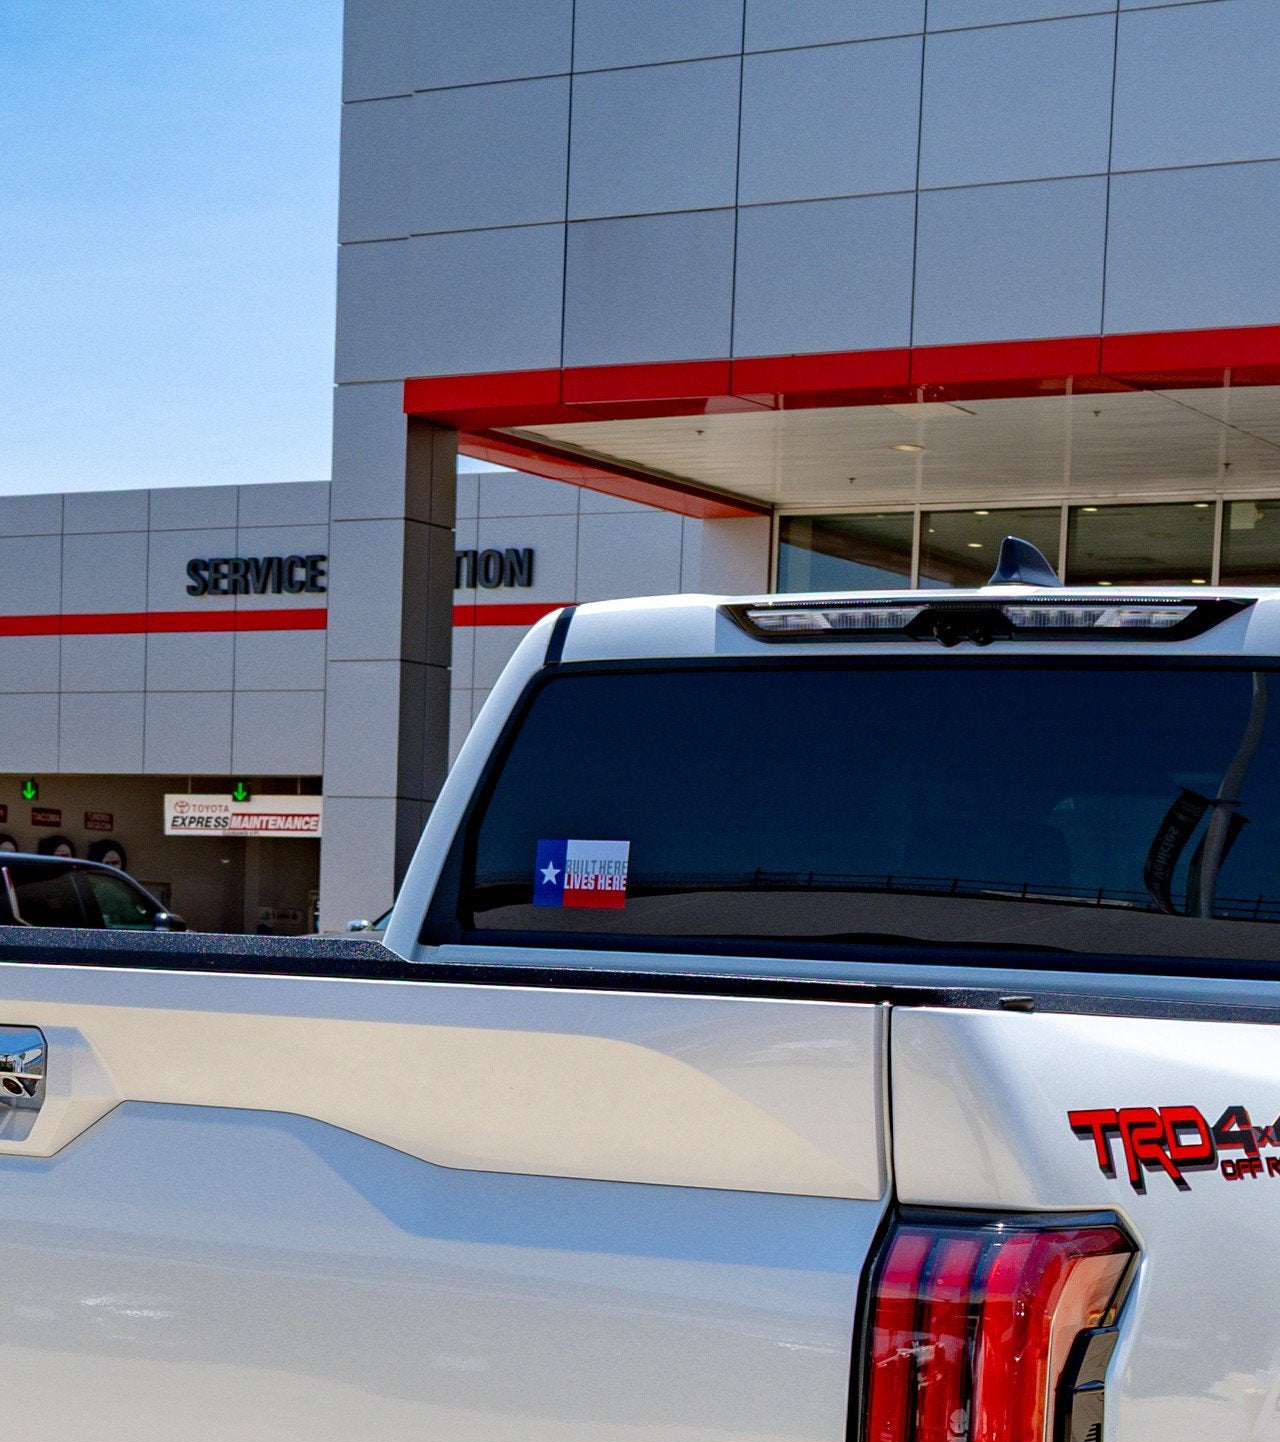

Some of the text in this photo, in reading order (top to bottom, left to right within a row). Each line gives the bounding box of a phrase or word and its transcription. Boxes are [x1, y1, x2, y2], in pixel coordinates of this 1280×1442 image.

[186, 555, 327, 596] SERVICE
[32, 812, 61, 822] TACOMA
[192, 804, 229, 813] TOYOTA
[171, 814, 320, 830] EXPRESS MAINTENANCE
[566, 859, 628, 875] BUILT HERE
[564, 873, 627, 891] LIVES HERE
[1067, 1105, 1219, 1195] TRD
[1220, 1157, 1264, 1181] OFF
